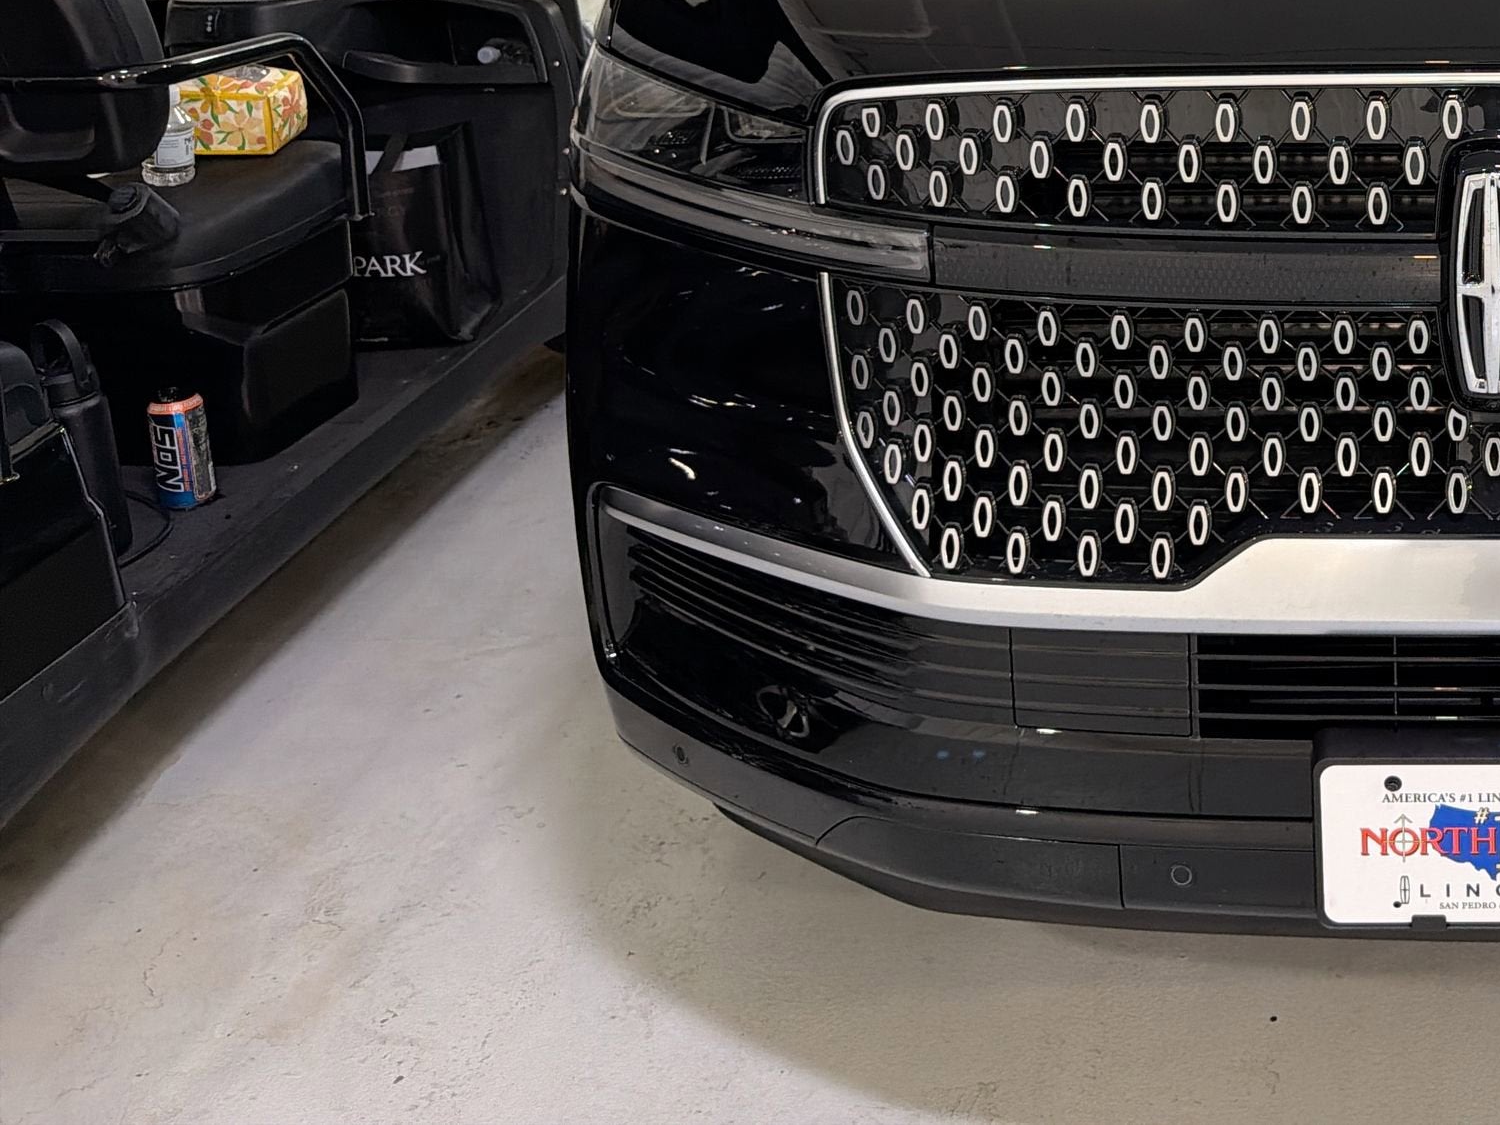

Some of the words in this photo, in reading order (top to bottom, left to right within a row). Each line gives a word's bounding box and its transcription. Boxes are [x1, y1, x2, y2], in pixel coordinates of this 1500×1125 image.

[353, 251, 427, 277] PARK
[151, 423, 184, 492] NOS
[1382, 793, 1456, 803] AMERICA'S
[1459, 793, 1473, 803] #1
[1360, 827, 1497, 856] NORTH
